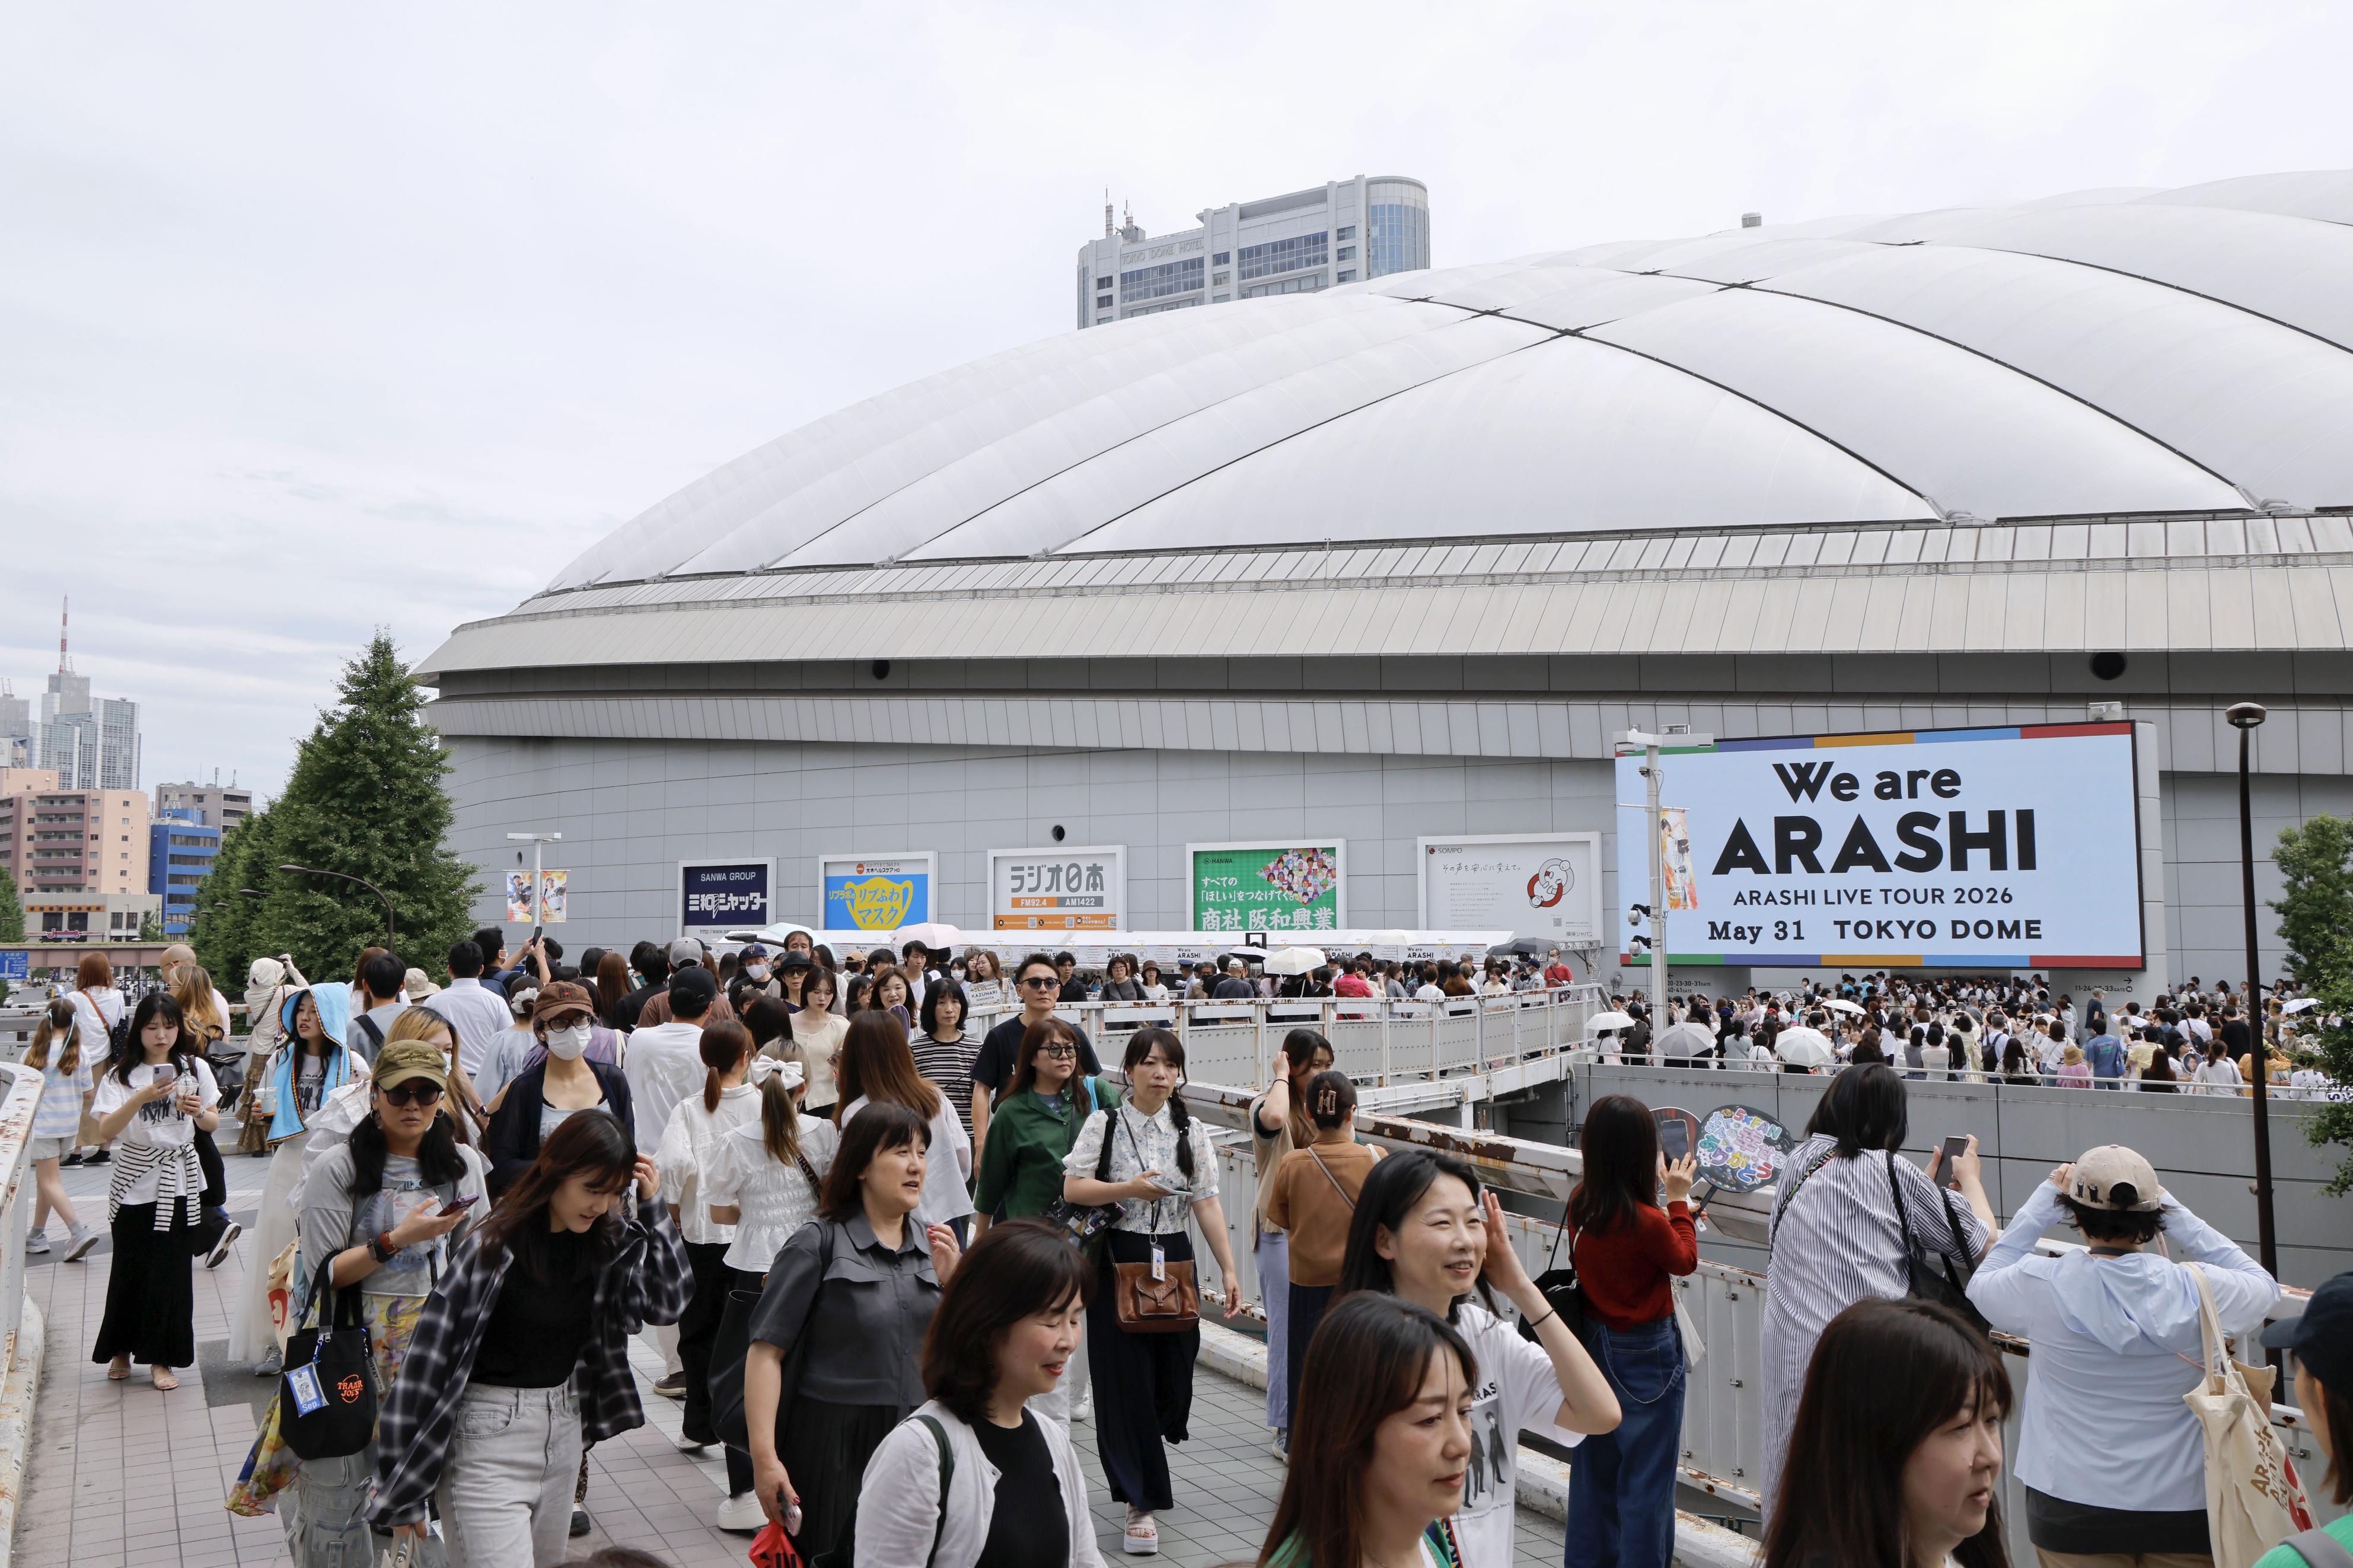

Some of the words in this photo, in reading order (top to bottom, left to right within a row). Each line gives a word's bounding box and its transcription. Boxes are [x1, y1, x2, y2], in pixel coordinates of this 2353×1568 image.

[1121, 252, 1145, 264] TOKYO
[1151, 246, 1174, 259] DOME
[1179, 240, 1204, 253] HOTEL
[1772, 761, 1859, 803] We
[1874, 769, 1961, 800] are
[1712, 810, 2036, 875] ARASHI
[701, 873, 726, 882] SANWA
[730, 872, 755, 881] GROUP
[1011, 863, 1104, 893] ラジオ日本
[1201, 876, 1237, 888] すべての
[688, 892, 767, 919] 三和シャッター
[859, 887, 900, 903] リブふわ
[1733, 890, 1815, 906] ARASHI
[1825, 889, 1871, 904] LIVE
[1880, 888, 1944, 904] TOUR
[1954, 887, 2012, 904] 2026
[857, 906, 898, 925] マスク
[1201, 907, 1243, 930] 商社
[1248, 906, 1334, 930] 阪和興業
[1708, 920, 1762, 945] May
[1775, 920, 1804, 940] 31
[1834, 919, 1936, 940] TOKYO
[1952, 919, 2041, 940] DOME
[971, 990, 997, 998] KAZUNARI
[1698, 1134, 1772, 1183] ありがとう
[367, 1357, 379, 1378] ARASHI
[302, 1401, 320, 1411] Sep.
